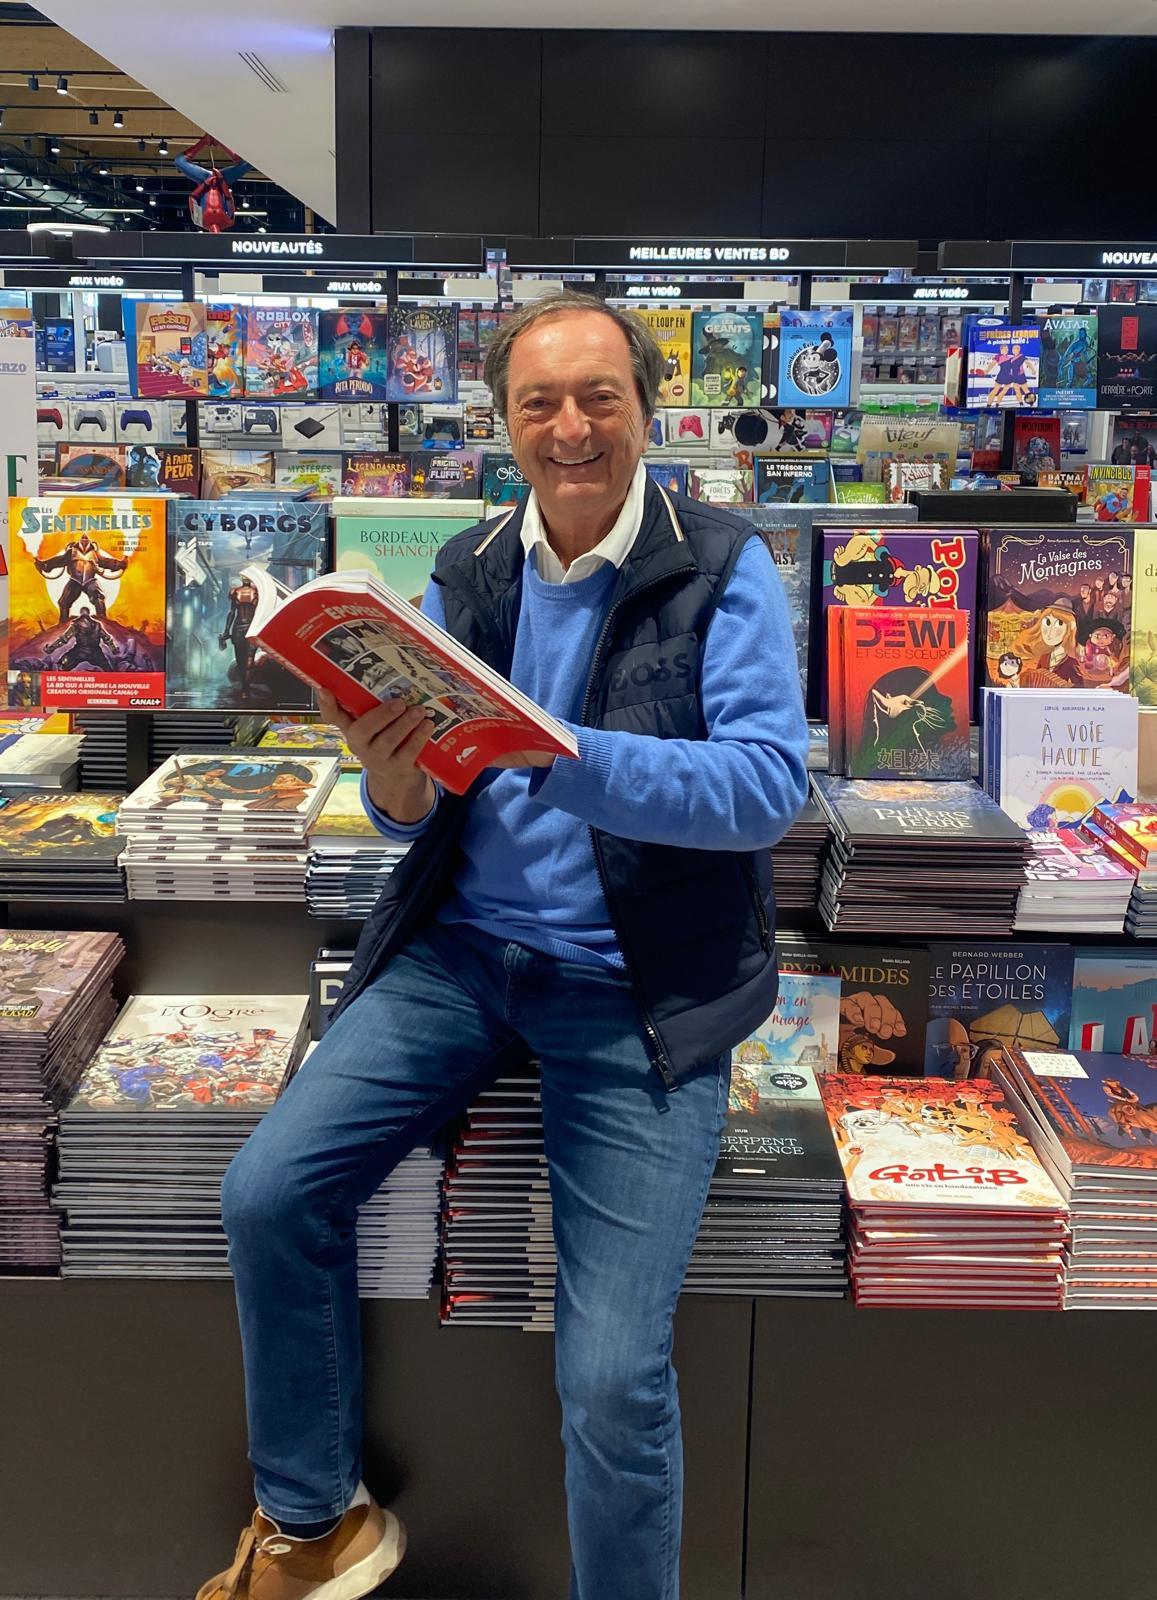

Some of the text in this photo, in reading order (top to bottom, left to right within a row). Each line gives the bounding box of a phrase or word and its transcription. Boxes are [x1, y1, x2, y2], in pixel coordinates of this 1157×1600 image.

[232, 240, 323, 255] NOUVEAUTÉS
[630, 247, 789, 260] MEILLEURES VENTES BD
[69, 275, 124, 286] JEUX VIDÉO
[327, 281, 382, 292] JEUX VIDÉO
[626, 285, 681, 297] JEUX VIDÉO
[913, 287, 969, 298] JEUX VIDÉO
[256, 311, 311, 323] ROBLOX
[648, 317, 686, 328] LE LOUP EN
[410, 320, 435, 330] L'AVENT
[1044, 319, 1090, 331] AVATAR
[1132, 385, 1154, 396] PORTE
[899, 442, 919, 451] 2026
[165, 453, 192, 465] À FAIRE
[165, 465, 194, 479] PEUR
[287, 464, 332, 473] MYSTÈRES
[777, 463, 802, 471] TRÉSOR
[430, 470, 460, 480] FLUFFY
[1090, 466, 1132, 481] INVINCIBLE
[709, 485, 731, 495] FORÊTS
[21, 507, 153, 534] SENTINELLES
[184, 513, 312, 534] CYBORGS
[360, 531, 439, 544] BORDEAUX
[1048, 552, 1070, 563] Valse
[1073, 549, 1087, 559] des
[1018, 558, 1102, 584] Montagnes
[856, 619, 956, 649] DEWI
[856, 649, 870, 659] ET
[875, 649, 901, 660] SES
[130, 698, 161, 706] CANAL+
[1041, 718, 1105, 743] À VOIE
[877, 747, 941, 770] 姐妹
[1041, 747, 1103, 767] HAUTE
[950, 964, 1046, 980] PAPILLON
[962, 978, 1045, 1000] ÉTOILES
[795, 997, 808, 1007] en
[772, 1011, 812, 1031] nuage
[720, 1135, 797, 1147] SERPENT
[745, 1145, 805, 1155] LANCE
